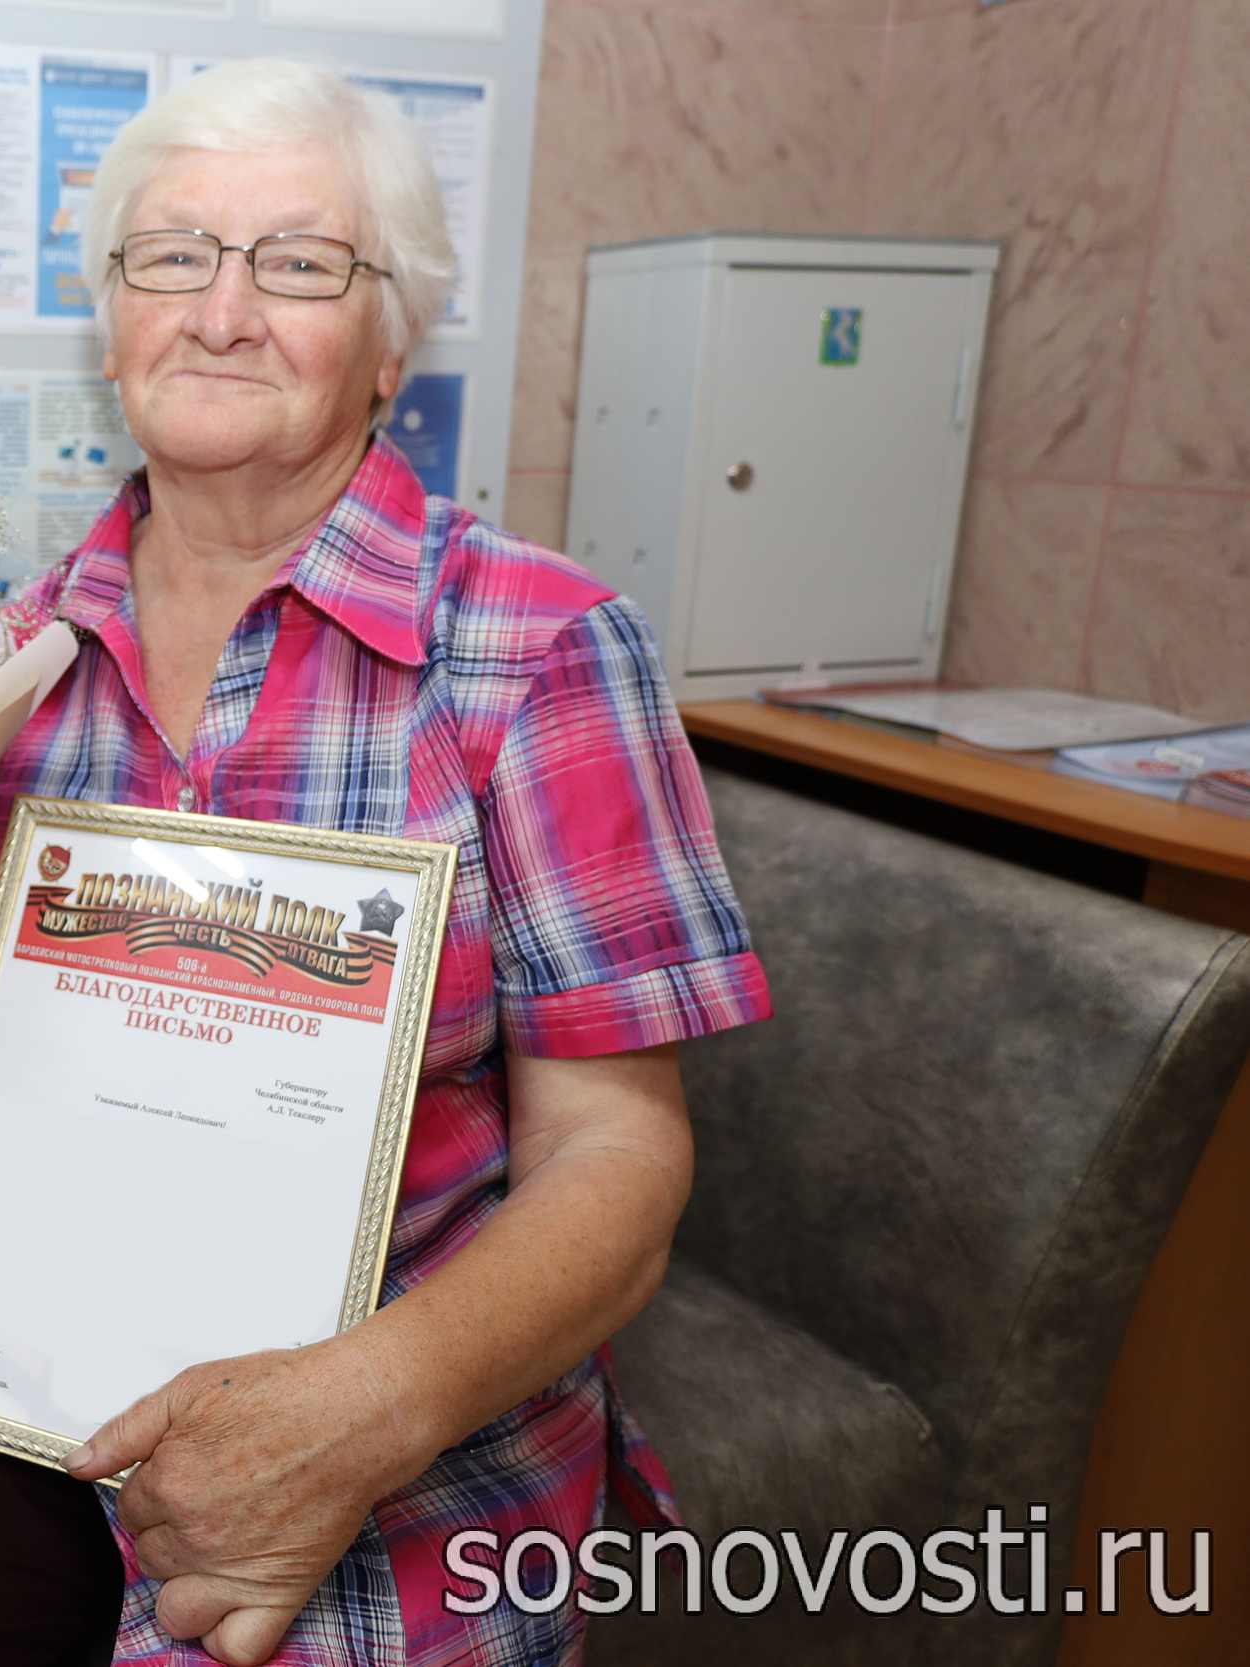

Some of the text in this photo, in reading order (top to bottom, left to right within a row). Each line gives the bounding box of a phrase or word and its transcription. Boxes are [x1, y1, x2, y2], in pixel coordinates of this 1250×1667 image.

[41, 909, 130, 933] МУЖЕСТВО
[174, 922, 232, 948] ЧЕСТЬ
[265, 894, 346, 948] ПОЛК
[287, 942, 348, 979] ОТВАГА
[66, 952, 138, 974] МОТОСТРЕЛКОВЫЙ
[138, 964, 191, 983] ПОЗНАНСКИЙ
[279, 989, 313, 1006] ОРДЕНА
[314, 994, 359, 1014] СУВОРОВА
[360, 1003, 385, 1019] ПОЛК
[54, 971, 322, 1038] БЛАГОДАРСТВЕННОЕ
[124, 1009, 234, 1045] ПИСЬМО
[254, 1088, 344, 1113] Челябинской области
[274, 1079, 328, 1098] Губернатору
[94, 1093, 227, 1129] Уважаемый Алексей Леонидович!
[287, 1108, 327, 1125] Текслеру
